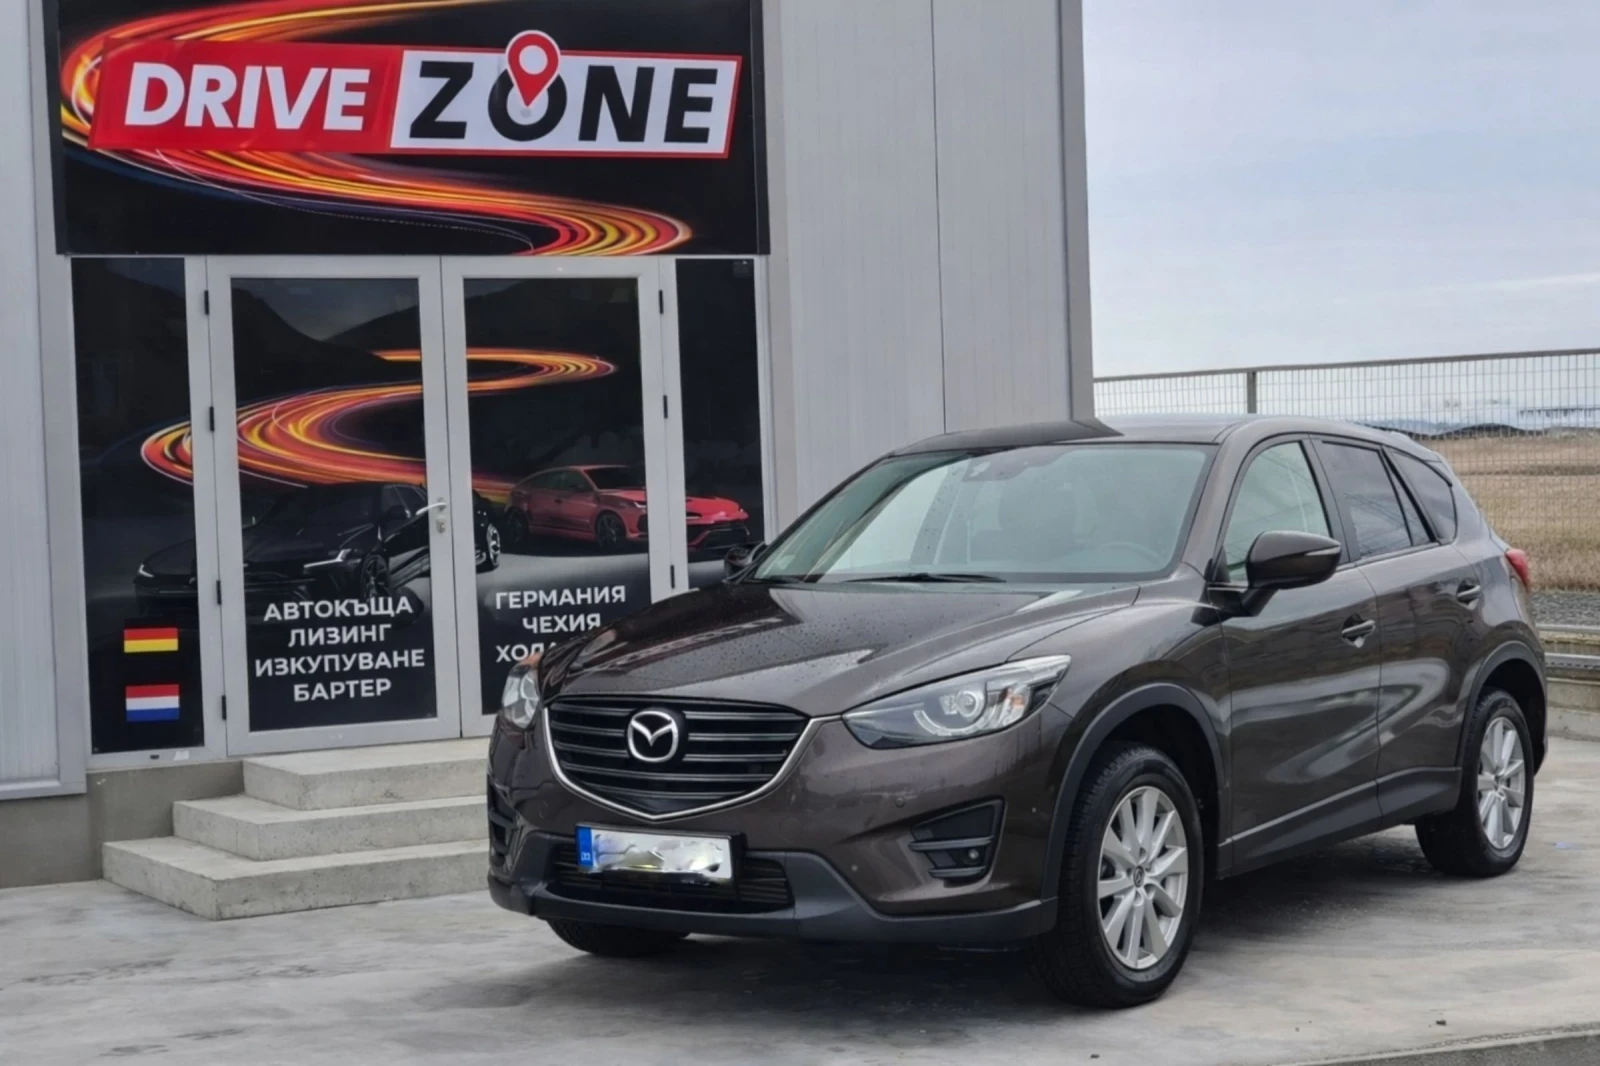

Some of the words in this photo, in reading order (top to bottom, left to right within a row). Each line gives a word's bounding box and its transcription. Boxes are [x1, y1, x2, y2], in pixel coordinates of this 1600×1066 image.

[125, 62, 370, 131] DRIVE
[409, 60, 718, 143] ZONE
[263, 596, 413, 621] АВТОКЪЩА
[495, 585, 626, 610] ГЕРМАНИЯ
[288, 624, 392, 648] ЛИЗИНГ
[522, 613, 601, 634] ЧЕХИЯ
[255, 649, 425, 677] ИЗКУПУВАНЕ
[293, 678, 392, 702] БАРТЕР
